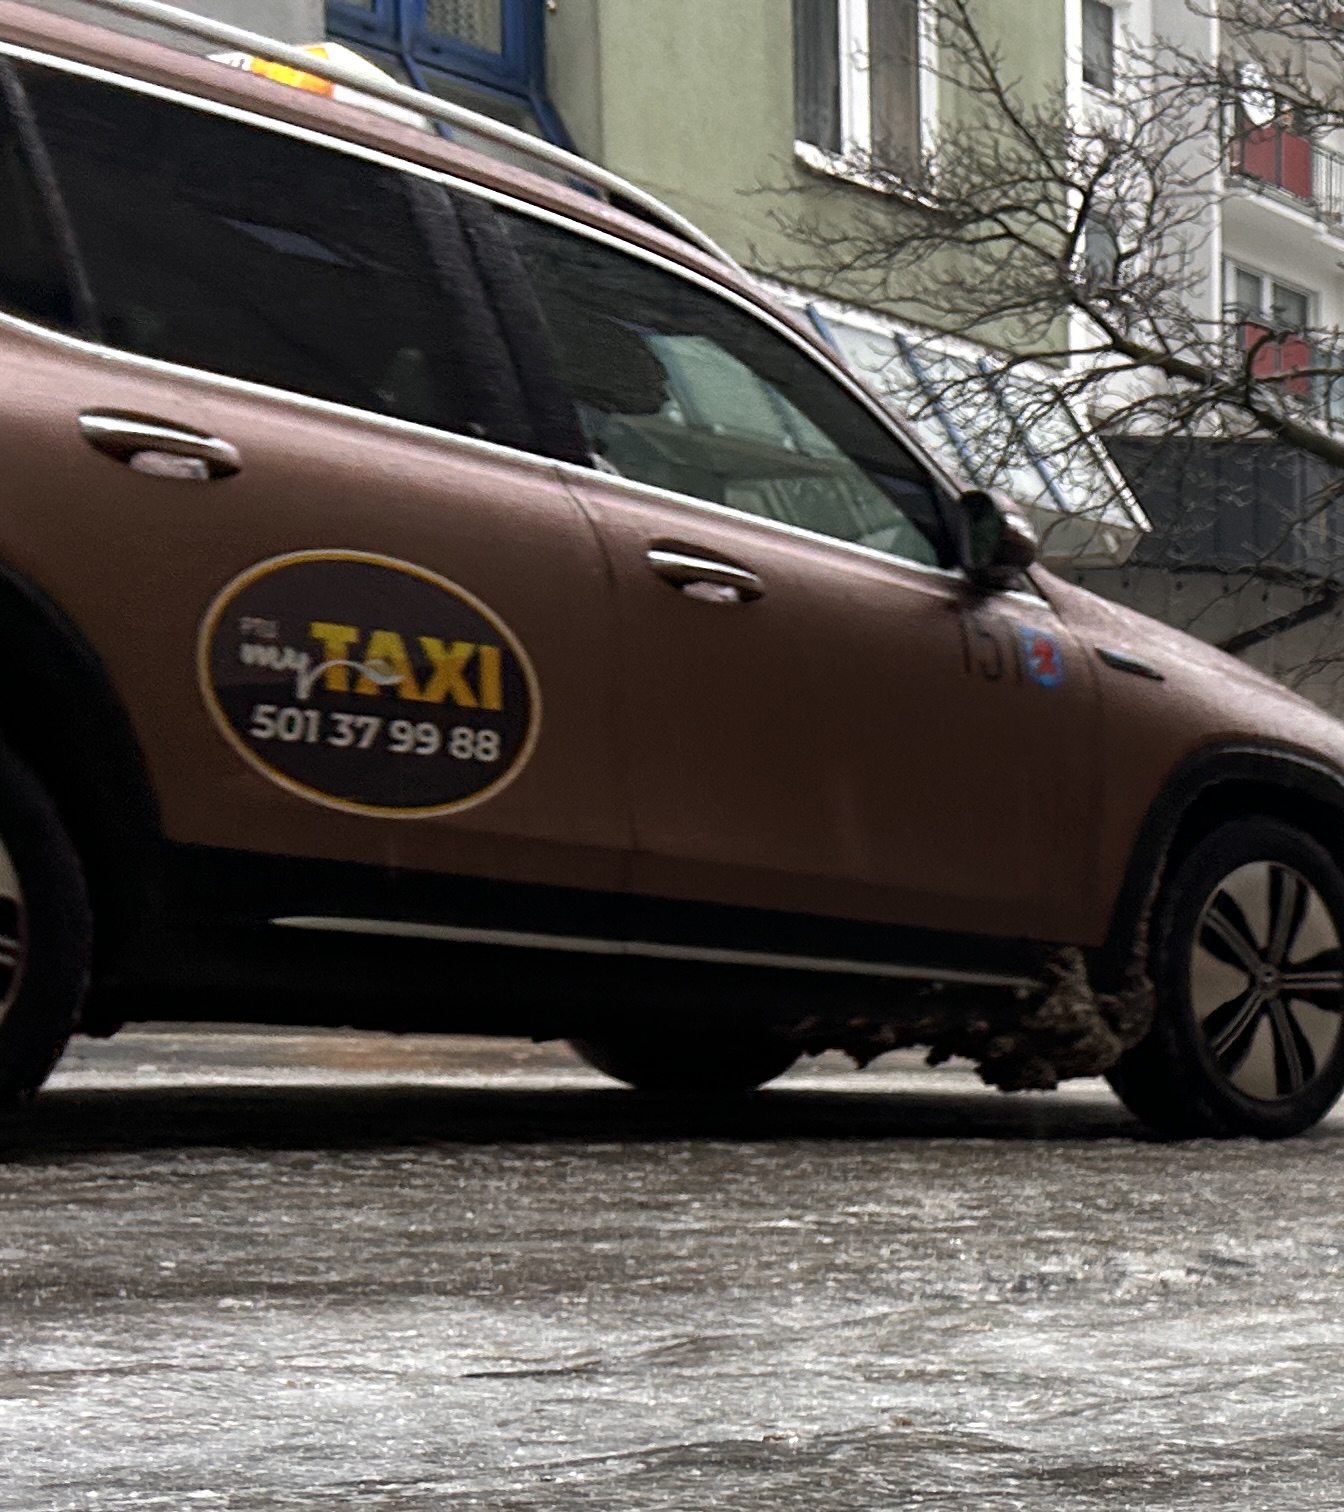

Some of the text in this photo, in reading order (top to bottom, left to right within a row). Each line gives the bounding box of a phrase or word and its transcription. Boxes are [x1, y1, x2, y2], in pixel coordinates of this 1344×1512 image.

[238, 621, 502, 711] my TAXI
[250, 703, 500, 762] 501 37 99 88
